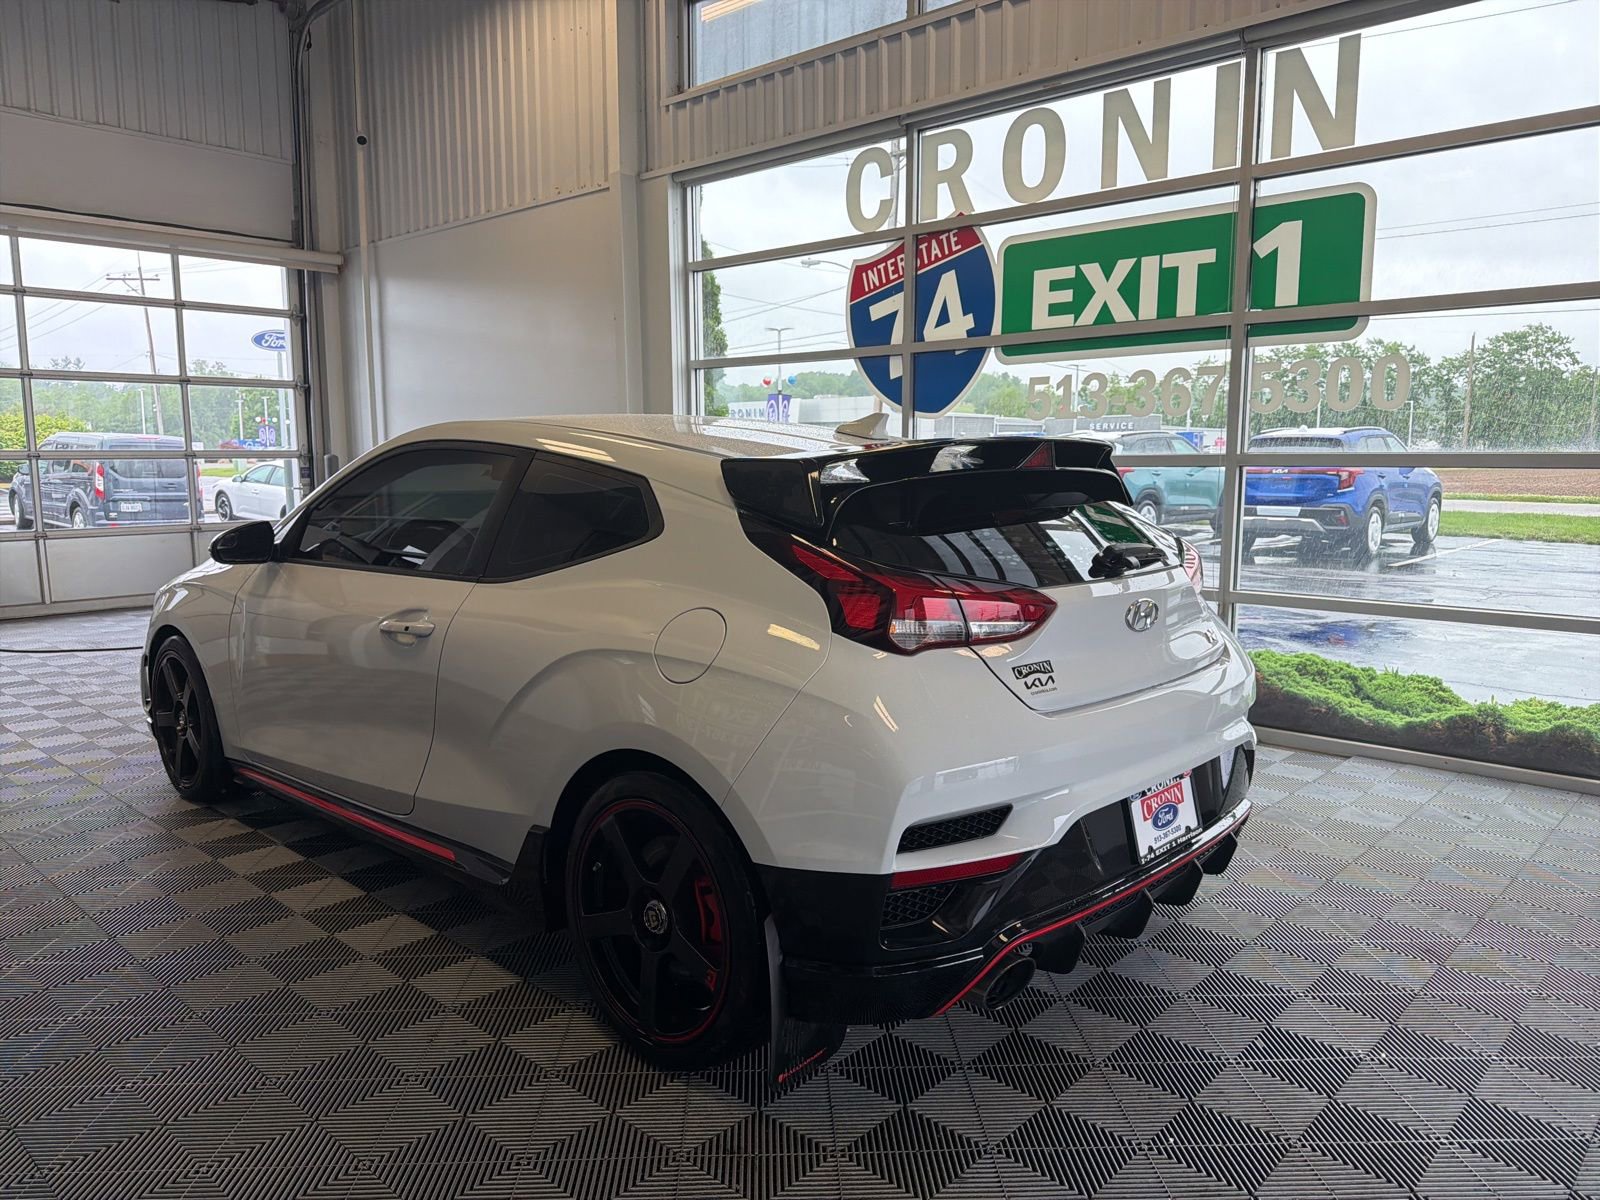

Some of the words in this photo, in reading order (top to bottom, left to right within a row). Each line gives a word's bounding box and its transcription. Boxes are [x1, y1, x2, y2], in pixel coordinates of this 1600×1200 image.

[846, 33, 1362, 233] CRONIN
[862, 229, 962, 292] INTERTATE
[1031, 248, 1217, 331] EXIT
[1252, 220, 1304, 308] 1
[868, 268, 976, 380] 74
[261, 333, 287, 347] For
[1089, 422, 1135, 431] SERVICE
[1015, 661, 1052, 678] CRONIN
[1024, 675, 1055, 690] KIA
[1143, 784, 1182, 819] CRONIN
[1157, 807, 1175, 826] Ford
[1153, 824, 1182, 845] 513-367-5300
[1155, 842, 1171, 856] EXIT
[1177, 827, 1203, 845] Harrison
